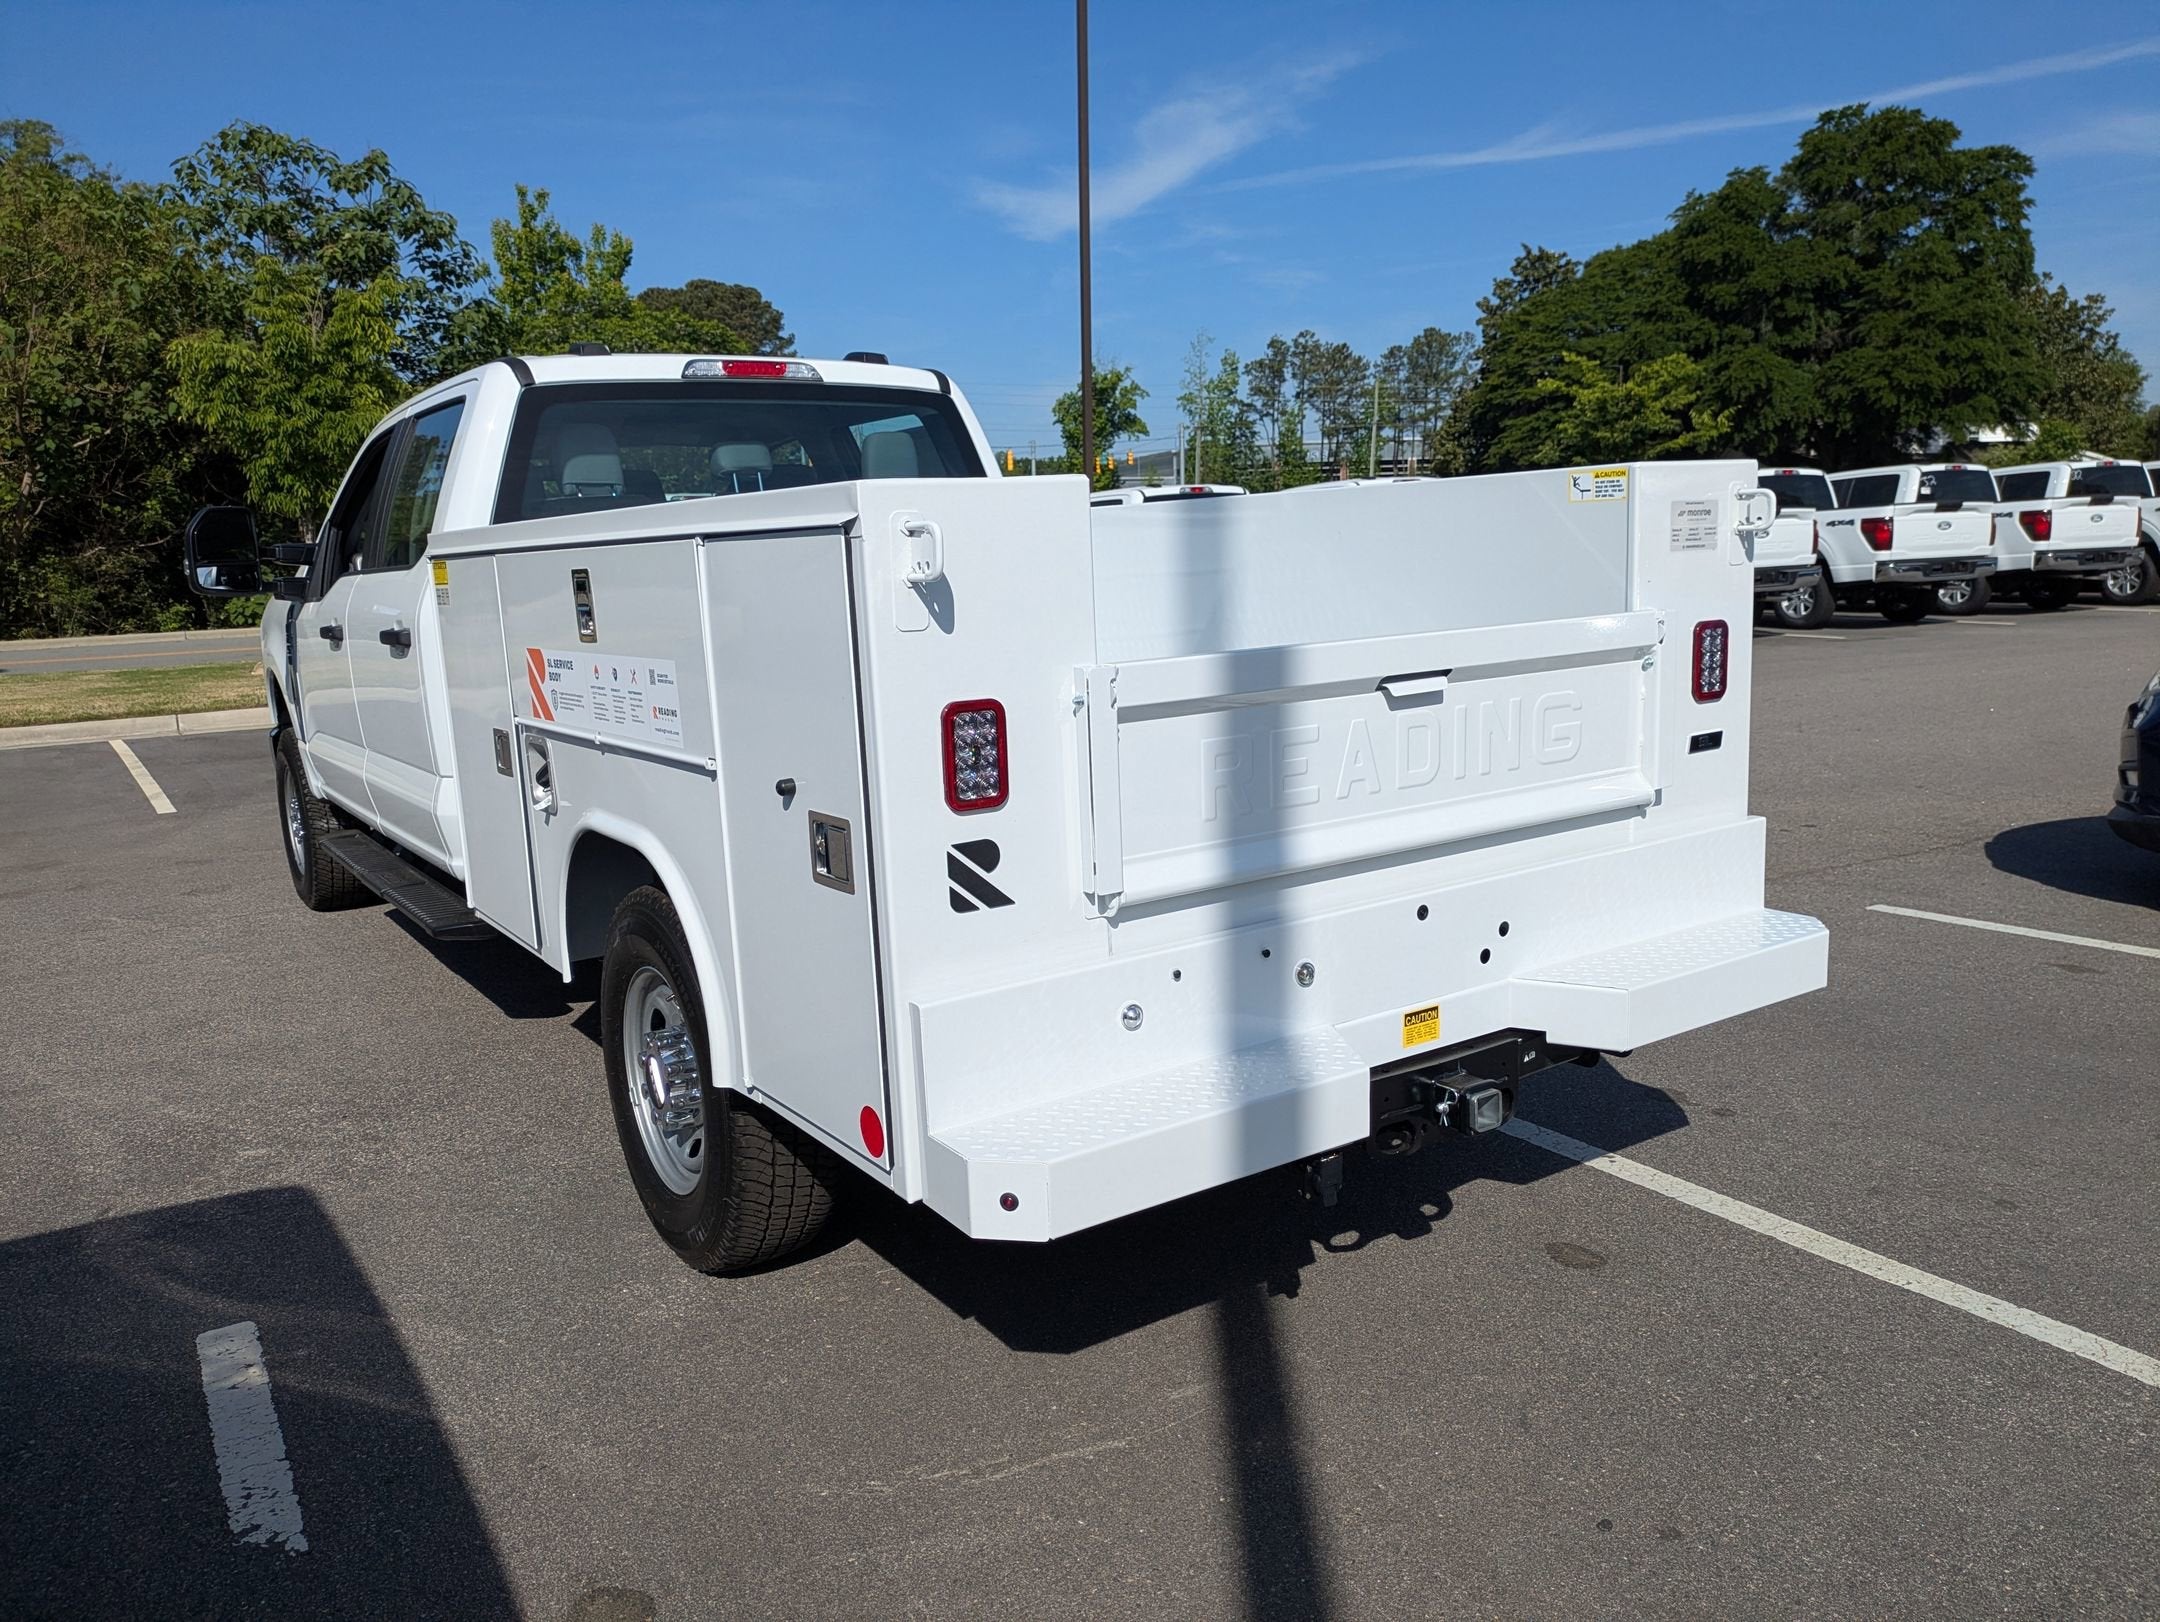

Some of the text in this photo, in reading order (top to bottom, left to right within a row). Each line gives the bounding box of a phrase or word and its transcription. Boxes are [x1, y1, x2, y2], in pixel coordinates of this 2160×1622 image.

[1600, 470, 1626, 478] CAUTION
[547, 658, 573, 670] SL SERVICE
[549, 671, 561, 682] BODY
[658, 706, 678, 718] READING
[1200, 690, 1584, 822] READING
[1405, 1009, 1438, 1026] CAUTION
